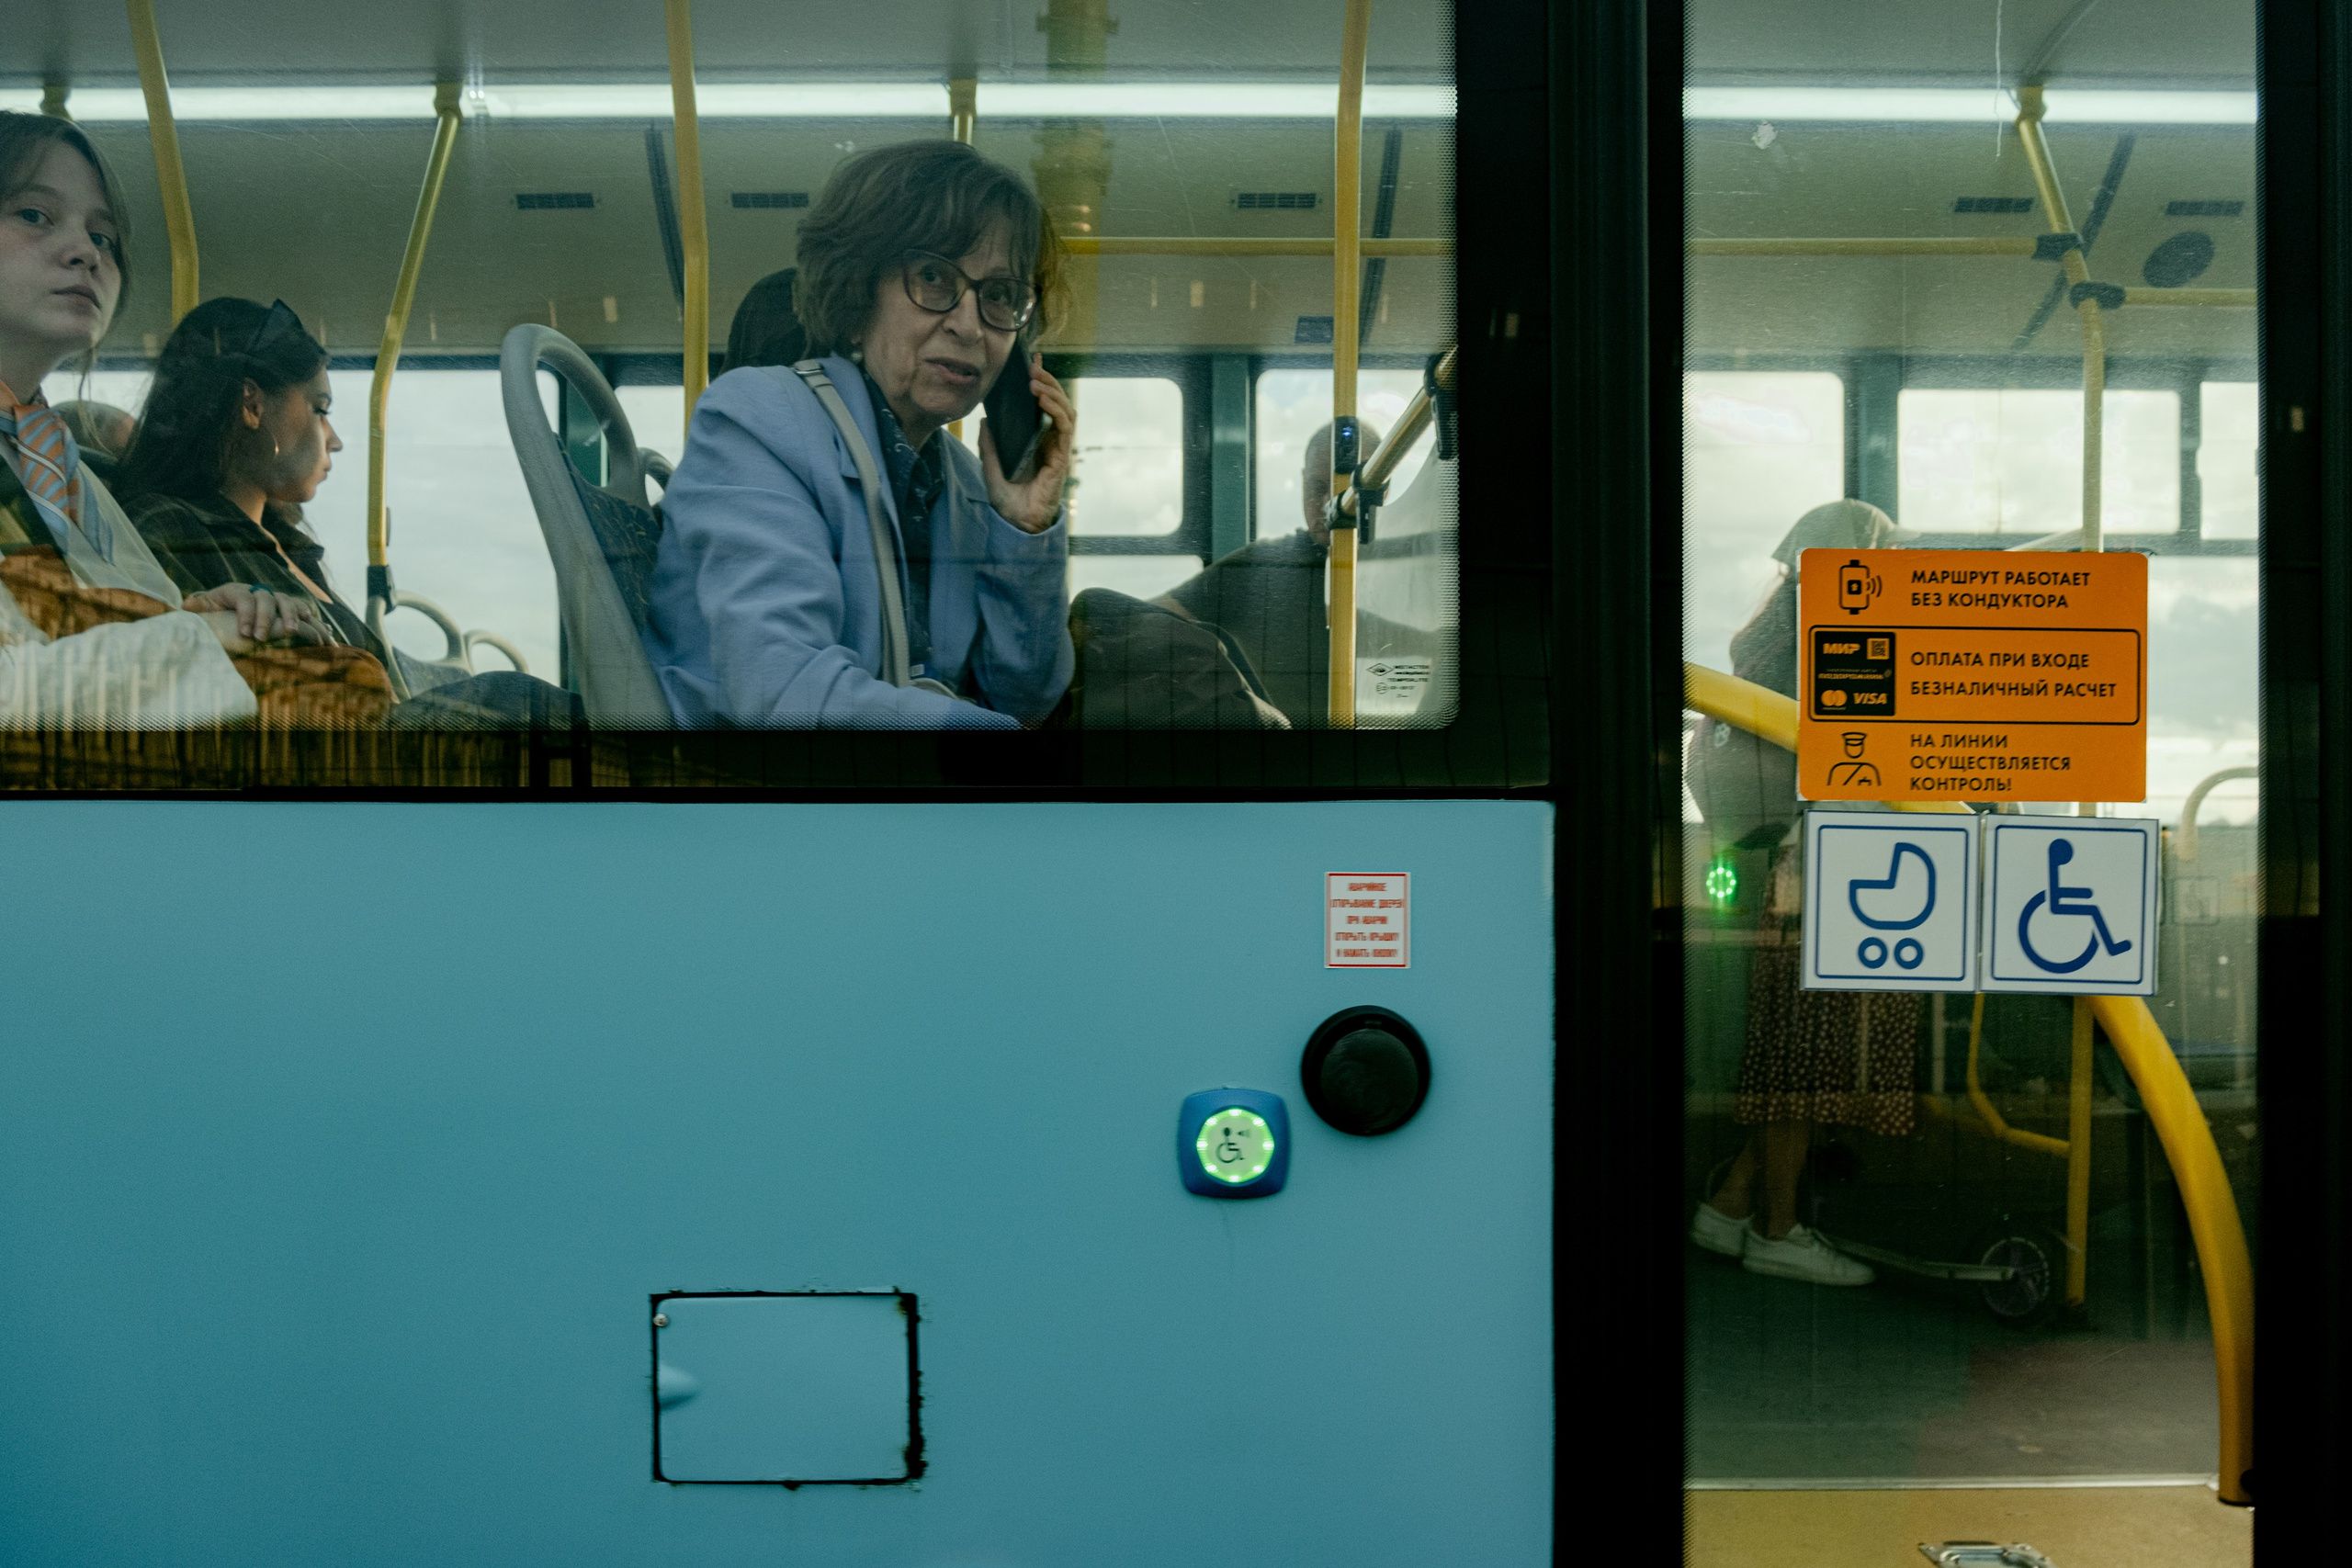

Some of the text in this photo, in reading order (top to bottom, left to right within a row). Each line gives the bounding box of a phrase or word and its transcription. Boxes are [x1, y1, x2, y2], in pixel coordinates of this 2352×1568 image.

[1911, 570, 2090, 586] МАРШРУТ РАБОТАЕТ
[1912, 592, 2068, 609] БЕЗ КОНДУКТОРА
[1911, 652, 2090, 670] ОПЛАТА ПРИ ВХОДЕ
[1911, 680, 2117, 697] БЕЗНАЛИЧНЫЙ РАСЧЕТ
[1852, 693, 1888, 705] VISA
[1911, 734, 2008, 749] НА ЛИНИИ
[1910, 755, 2072, 772] ОСУЩЕСТВЛЯЕТСЯ
[1910, 777, 2012, 791] КОНТРОЛЬ!
